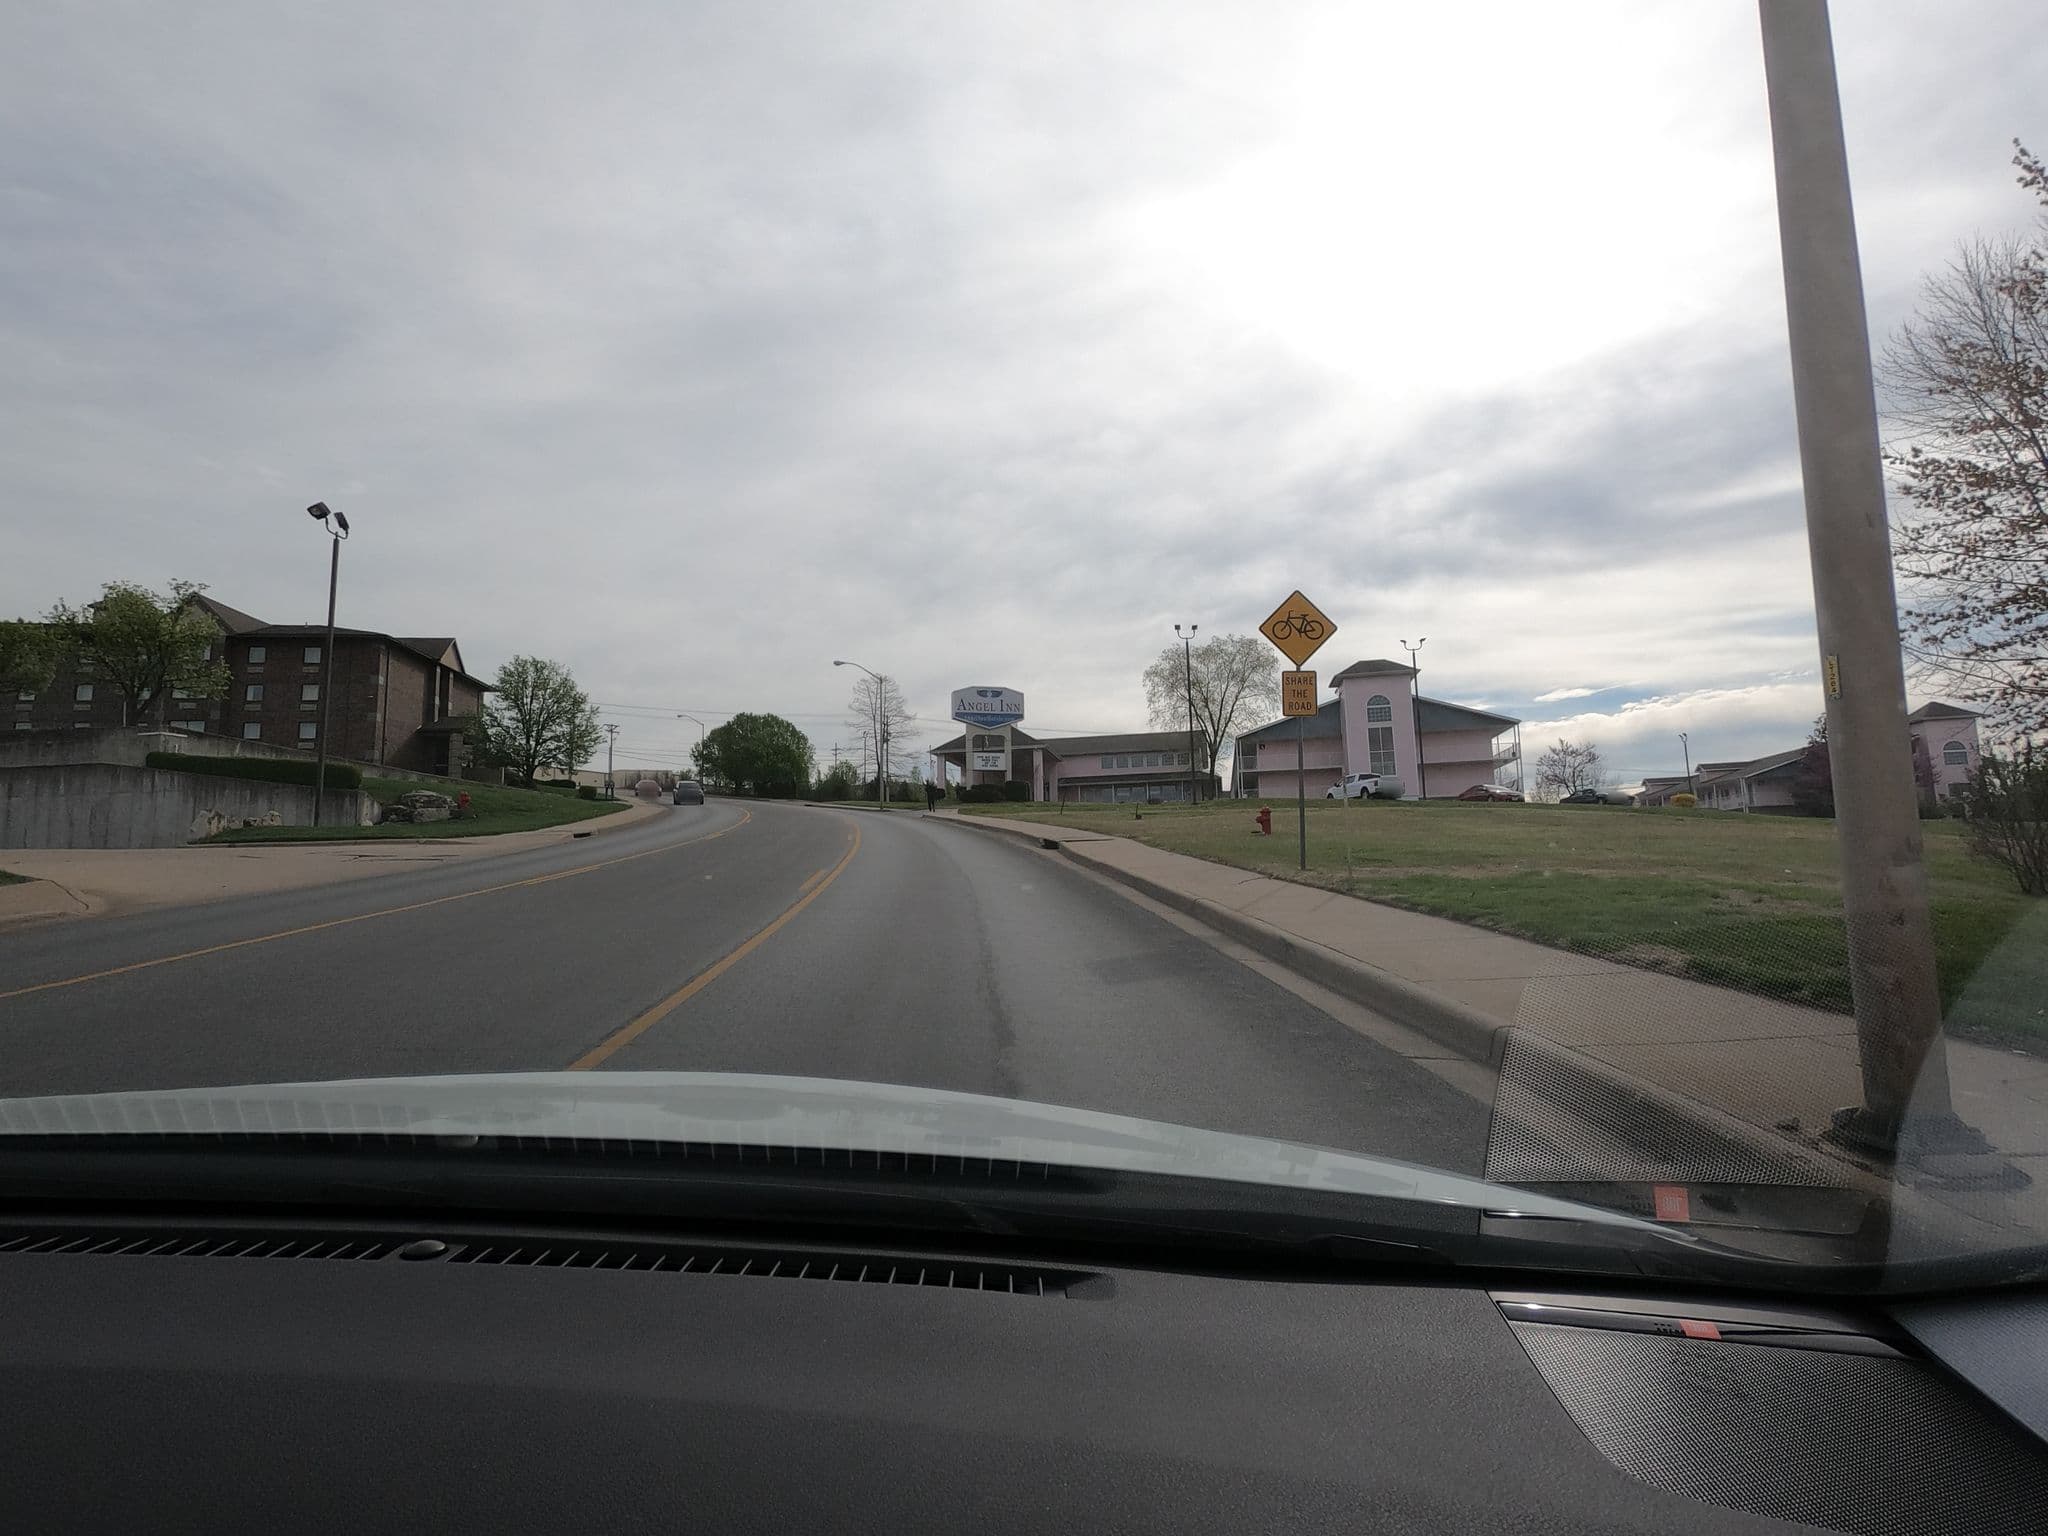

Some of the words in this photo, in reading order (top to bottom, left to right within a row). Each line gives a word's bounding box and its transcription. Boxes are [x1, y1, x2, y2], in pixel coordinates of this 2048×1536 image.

[1285, 677, 1313, 686] SHARE
[1292, 689, 1308, 698] THE
[957, 699, 996, 712] ANGEL
[1000, 699, 1020, 712] INN
[1288, 701, 1312, 711] ROAD
